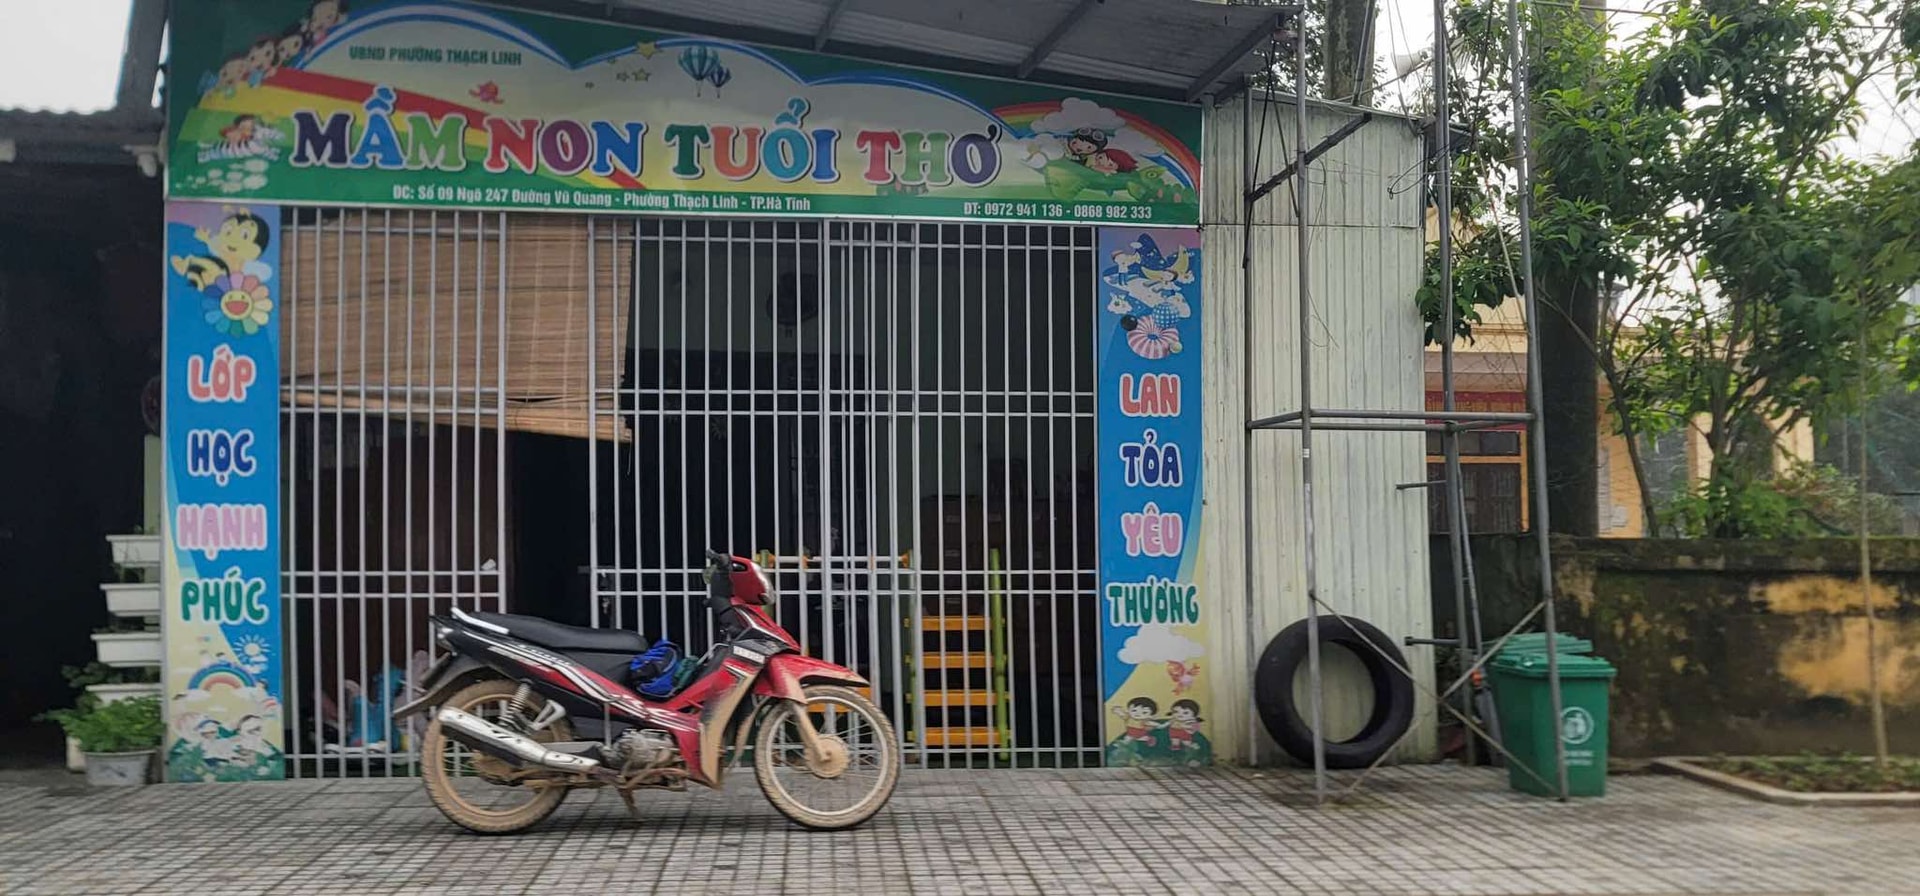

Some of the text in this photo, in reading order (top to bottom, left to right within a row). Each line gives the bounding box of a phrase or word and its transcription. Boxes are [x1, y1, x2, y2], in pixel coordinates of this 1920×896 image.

[349, 45, 386, 60] UBND
[446, 49, 488, 67] THẠCH
[491, 51, 522, 65] LINH
[290, 84, 1003, 187] MẦM NON TUỔI THƠ
[418, 184, 435, 200] Số
[438, 187, 454, 201] 09
[485, 188, 509, 203] 247
[573, 191, 612, 208] Quang
[673, 194, 709, 211] Thạch
[712, 195, 739, 209] Linh
[984, 203, 1013, 216] 0972
[1016, 204, 1037, 217] 941
[1041, 204, 1063, 217] 136
[1073, 205, 1103, 218] 0868
[1106, 206, 1127, 219] 982
[1130, 206, 1152, 219] 333
[188, 344, 256, 401] LỚP
[1119, 373, 1181, 417] LAN
[188, 429, 256, 486] HỌC
[1119, 428, 1183, 487] TỎA
[177, 503, 267, 560] HẠNH
[1121, 501, 1183, 558] YÊU
[180, 566, 269, 625] PHÚC
[1106, 575, 1200, 626] THƯƠNG
